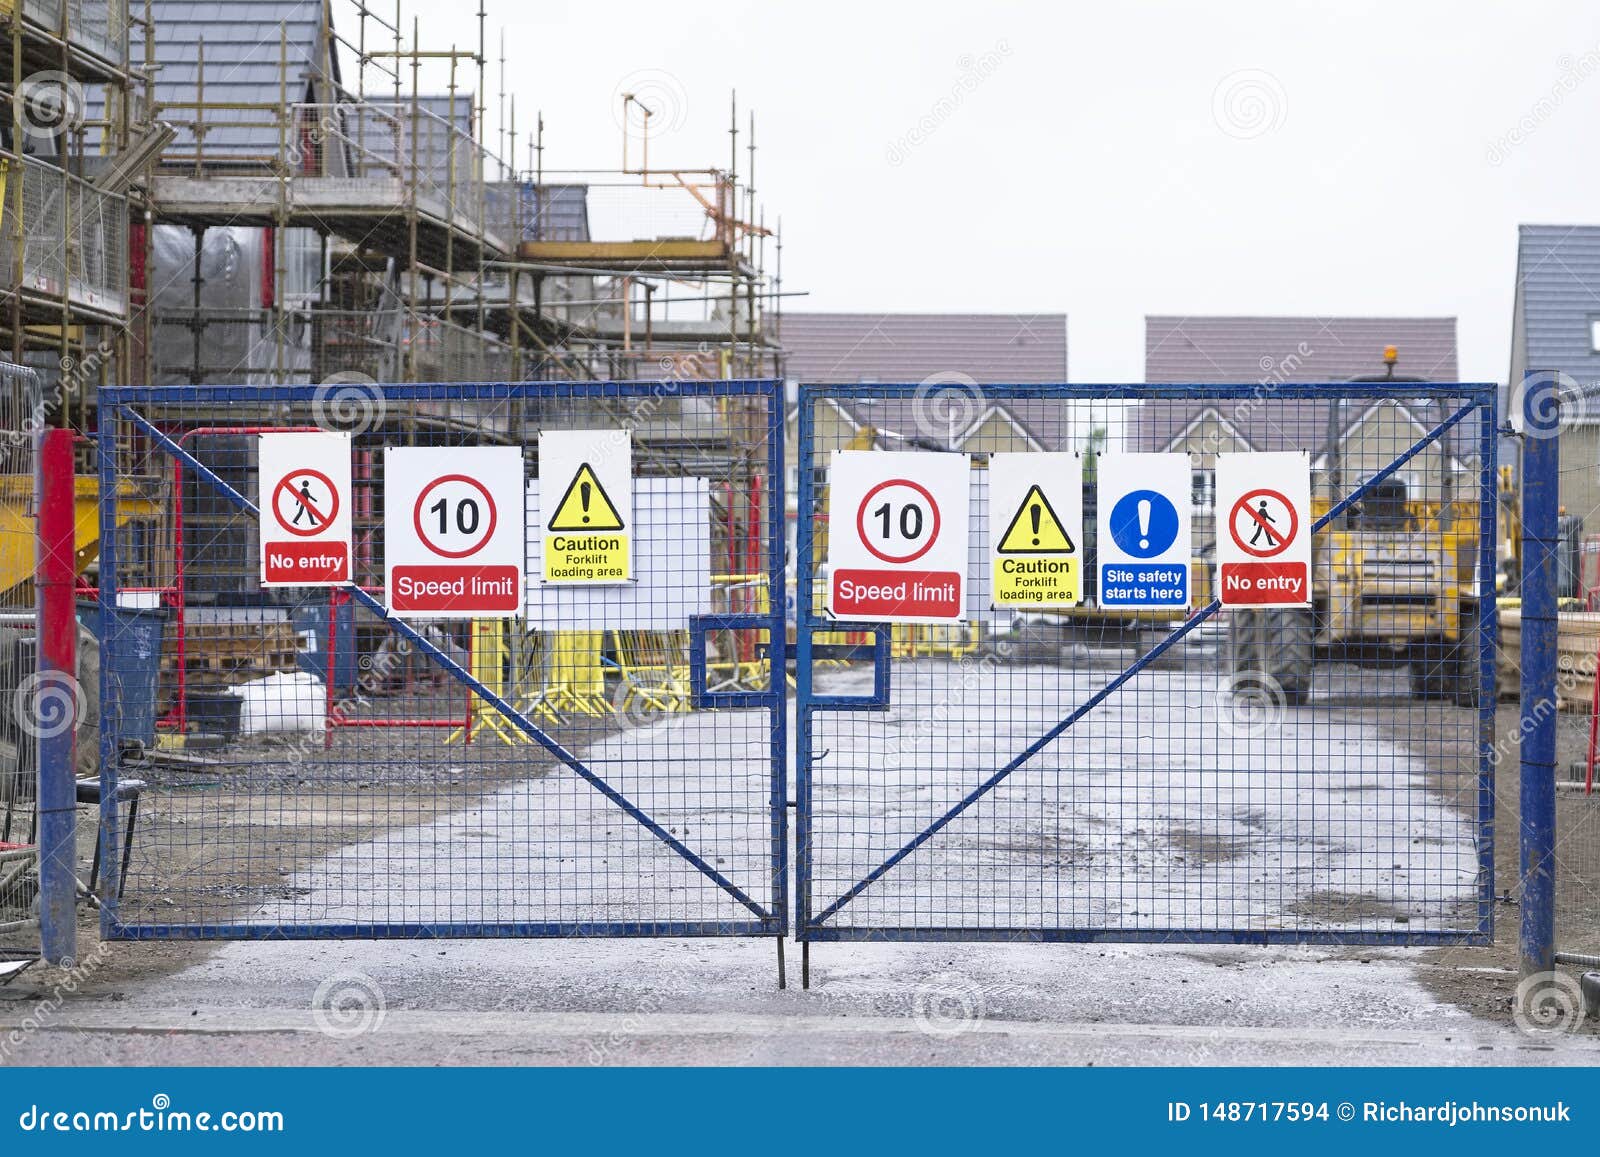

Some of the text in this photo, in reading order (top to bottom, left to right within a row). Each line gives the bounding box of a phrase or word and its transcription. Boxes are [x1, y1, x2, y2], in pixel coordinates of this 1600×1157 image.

[431, 498, 479, 535] 10
[874, 503, 923, 540] 10
[553, 536, 619, 551] Caution
[270, 554, 343, 572] No entry
[566, 554, 608, 565] Forklift
[1002, 559, 1069, 574] Caution
[551, 567, 623, 579] loading area
[1107, 569, 1182, 584] Site safety
[398, 576, 513, 600] Speed limit
[1015, 577, 1057, 587] Forklift
[1227, 574, 1302, 593] No entry
[839, 580, 955, 603] Speed limit
[1000, 589, 1073, 601] loading area
[1105, 586, 1183, 599] starts here
